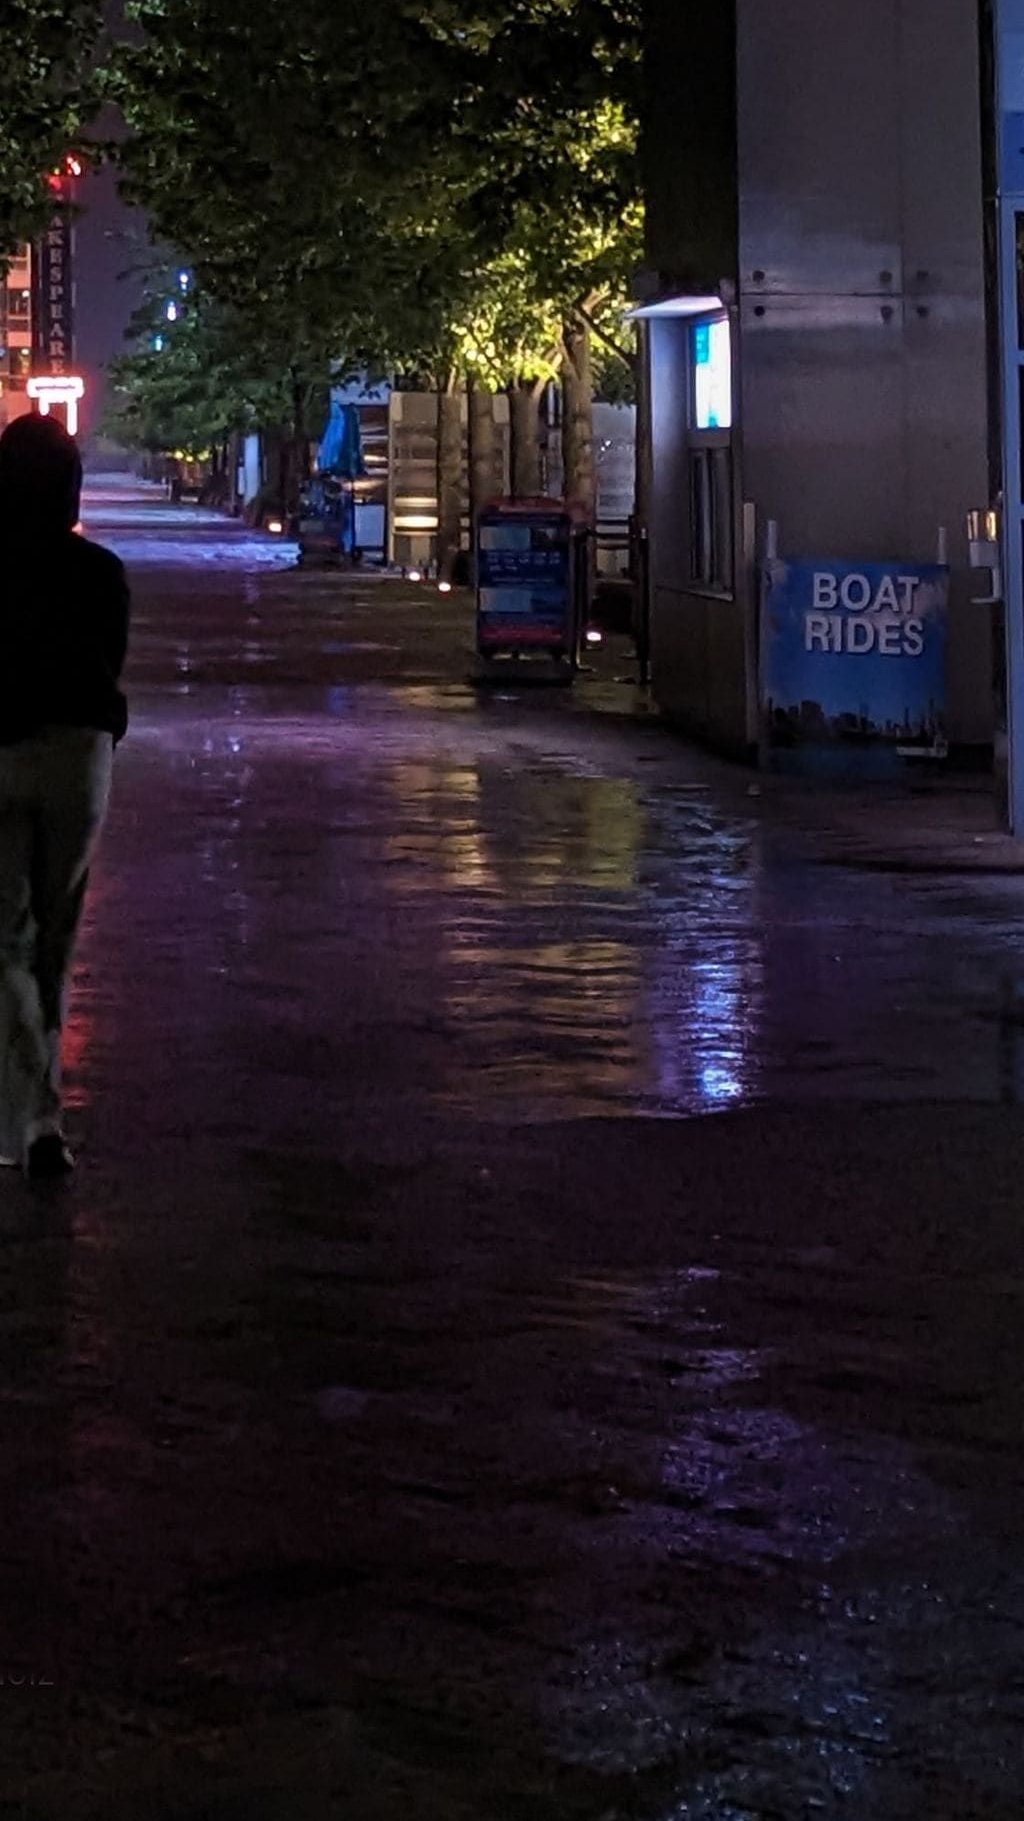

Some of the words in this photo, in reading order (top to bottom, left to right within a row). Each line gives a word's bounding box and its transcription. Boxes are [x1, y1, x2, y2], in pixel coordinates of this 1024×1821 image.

[47, 177, 66, 374] AKESPEARE
[812, 571, 920, 613] BOAT
[804, 614, 925, 657] RIDES
